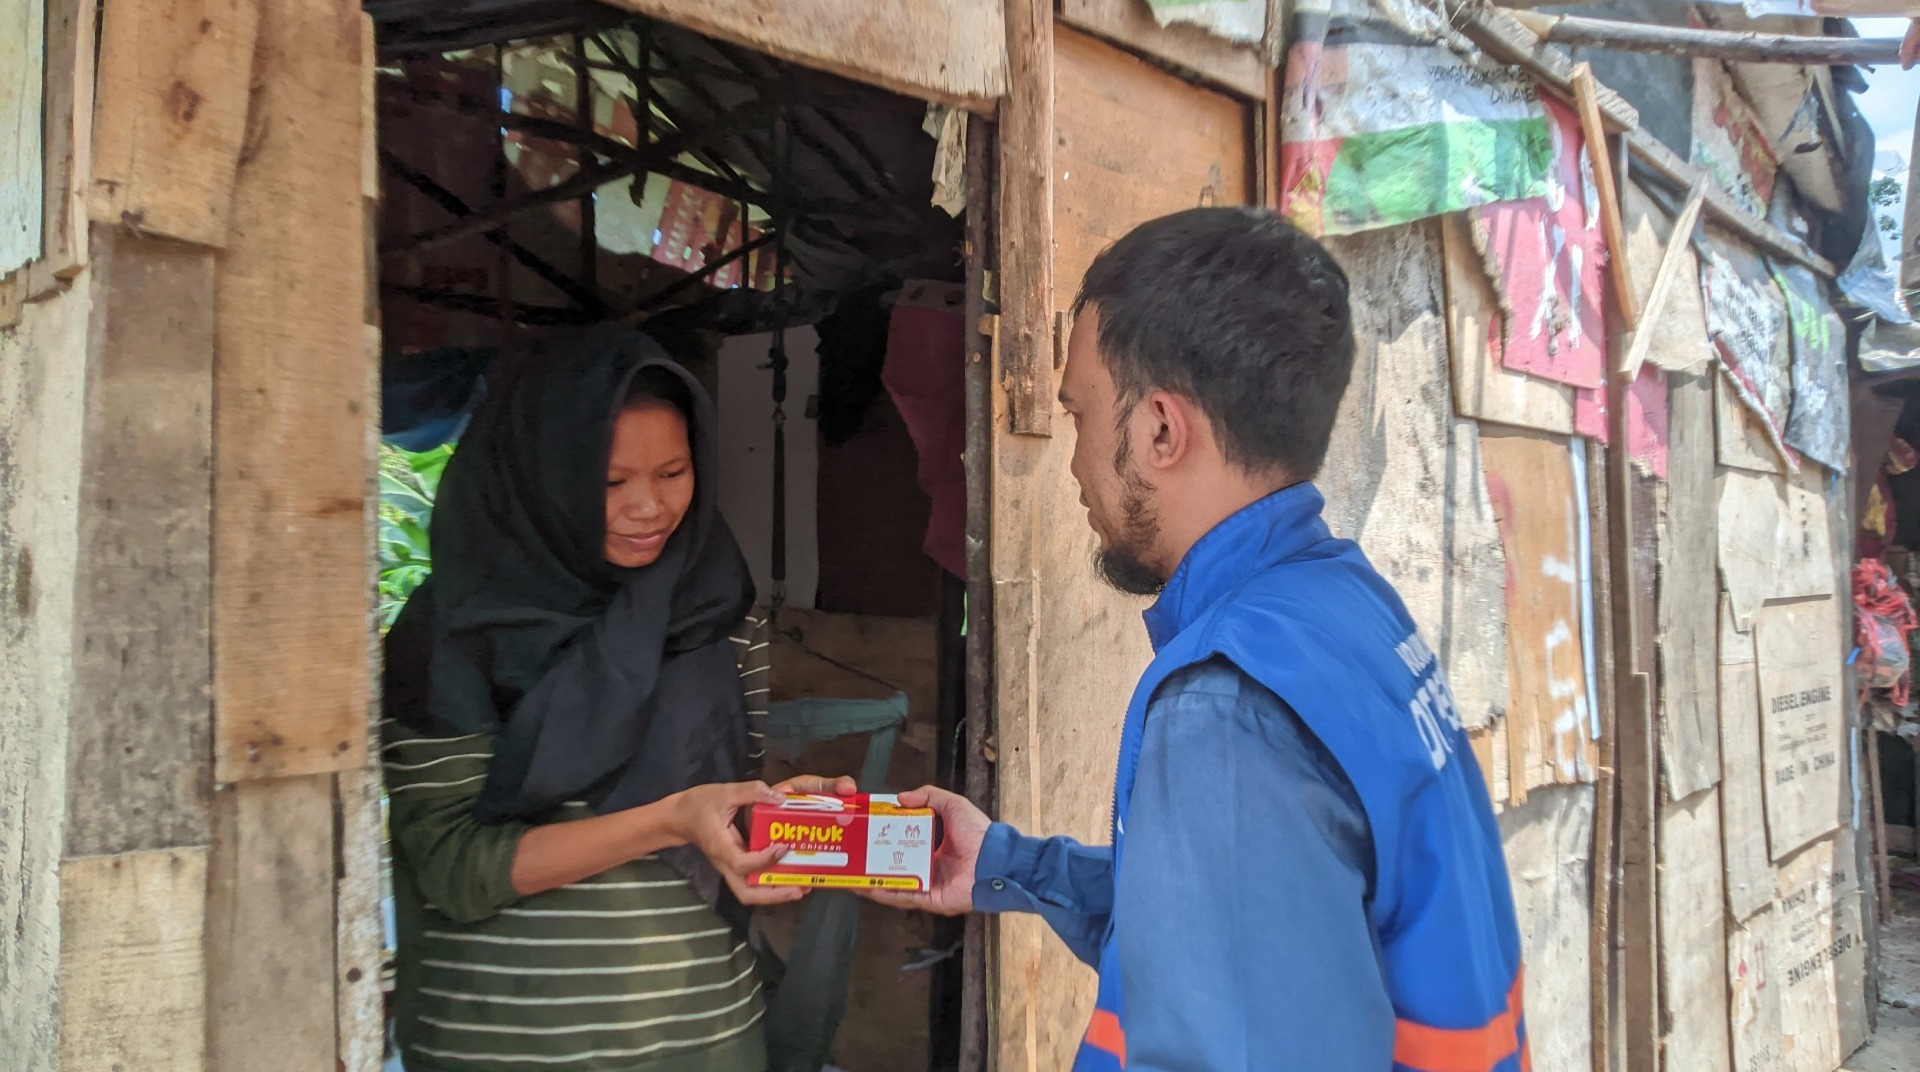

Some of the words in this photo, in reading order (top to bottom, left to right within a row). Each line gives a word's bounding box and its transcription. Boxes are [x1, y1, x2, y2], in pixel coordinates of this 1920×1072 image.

[1771, 693, 1799, 714] DIESEL
[1801, 686, 1831, 706] ENGINE
[1776, 765, 1794, 785] MADE
[1814, 752, 1835, 770] CHINA
[770, 821, 844, 843] Dkriuk
[800, 842, 842, 851] Chicken
[1788, 954, 1822, 987] ENGINE
